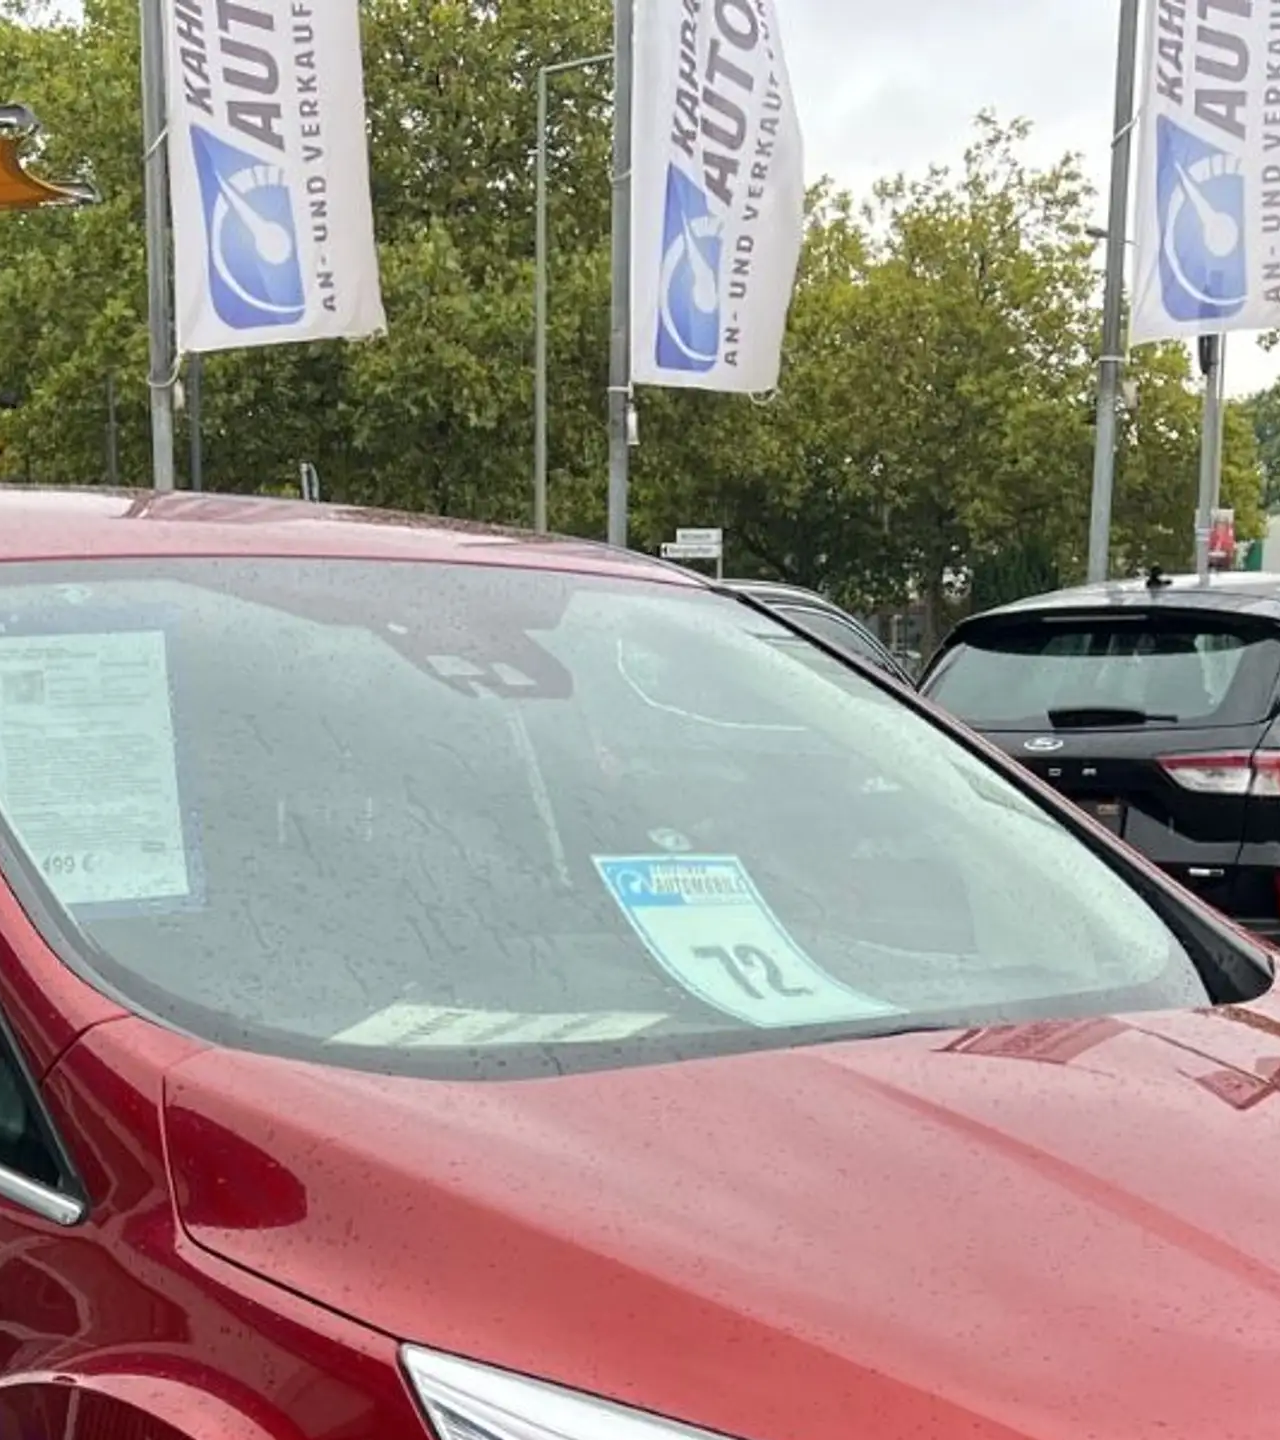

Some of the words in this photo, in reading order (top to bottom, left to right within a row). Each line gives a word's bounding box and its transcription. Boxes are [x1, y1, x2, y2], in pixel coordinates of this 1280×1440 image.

[291, 2, 325, 165] VERKAUF
[306, 176, 329, 243] UND
[728, 233, 755, 301] UND
